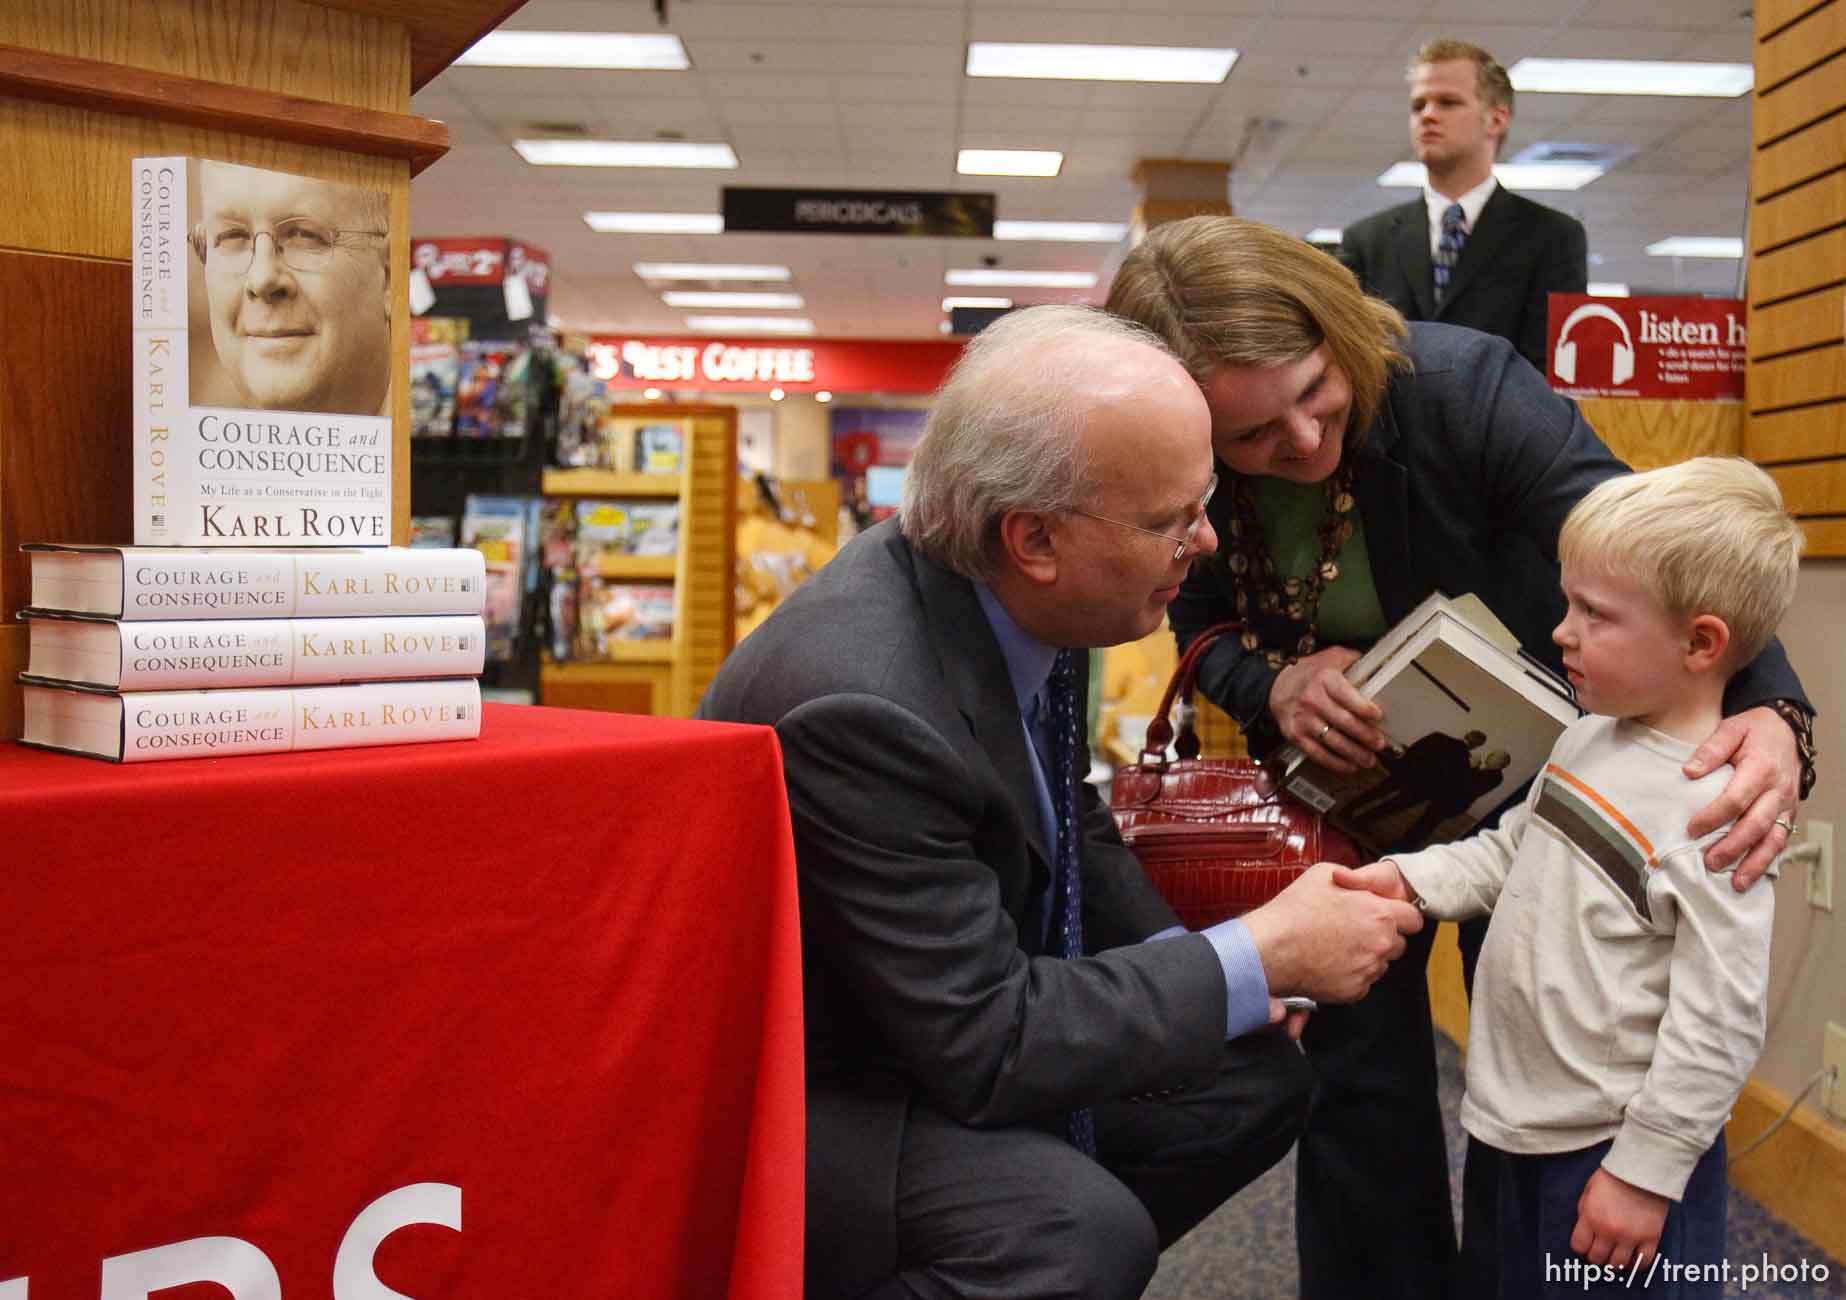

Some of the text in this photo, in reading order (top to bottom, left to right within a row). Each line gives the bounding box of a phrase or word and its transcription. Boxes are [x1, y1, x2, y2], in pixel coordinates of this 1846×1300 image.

[158, 168, 174, 280] COURAGE
[139, 168, 153, 319] CONSEQUENCE
[1639, 310, 1719, 344] listen
[622, 341, 698, 380] BEST
[703, 343, 814, 381] COFFEE
[149, 338, 169, 414] KARL
[199, 415, 378, 447] COURAGE and
[150, 426, 168, 507] ROVE
[199, 449, 385, 477] CONSEQUENCE
[200, 484, 216, 499] My
[221, 485, 240, 497] Life
[244, 488, 254, 496] as
[265, 486, 328, 498] Conservative
[331, 488, 341, 498] in
[343, 487, 357, 498] the
[361, 488, 384, 500] Fight
[200, 505, 384, 537] KARL ROVE
[136, 567, 248, 585] COURAGE
[303, 571, 374, 595] KARL
[384, 572, 455, 593] ROVE
[136, 591, 286, 608] CONSEQUENCE
[134, 633, 247, 650] COURAGE
[302, 633, 373, 656] KARL
[383, 632, 451, 654] ROVE
[134, 654, 283, 671] CONSEQUENCE
[136, 709, 248, 728] COURAGE
[302, 704, 371, 729] KARL
[383, 703, 451, 724] ROVE
[136, 728, 284, 749] CONSEQUENCE
